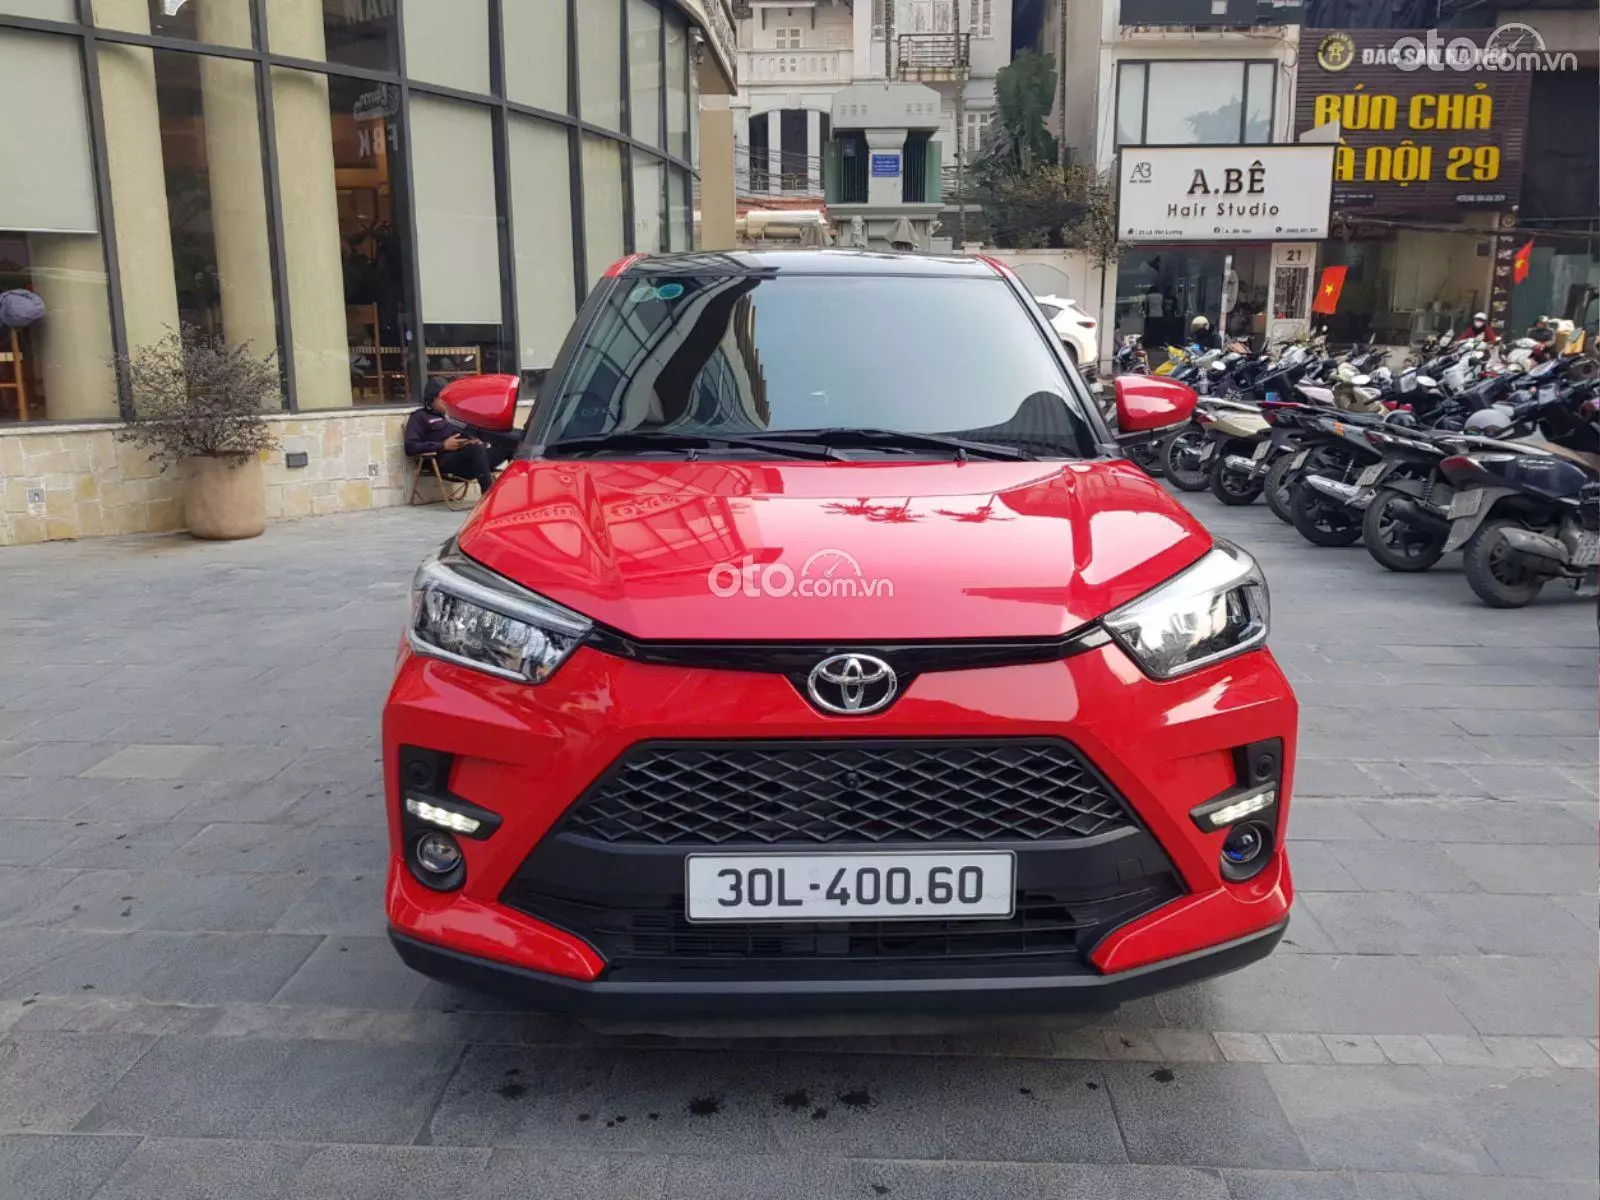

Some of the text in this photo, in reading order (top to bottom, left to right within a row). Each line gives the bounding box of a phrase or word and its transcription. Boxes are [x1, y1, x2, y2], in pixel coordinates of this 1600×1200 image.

[1314, 83, 1493, 130] BÚN CHẢ
[1187, 160, 1266, 195] A.BÊ
[1334, 139, 1500, 187] À NỘI 29
[1167, 202, 1280, 218] Hair Studio
[1287, 249, 1302, 261] 21
[717, 865, 984, 907] 30L-400.60
